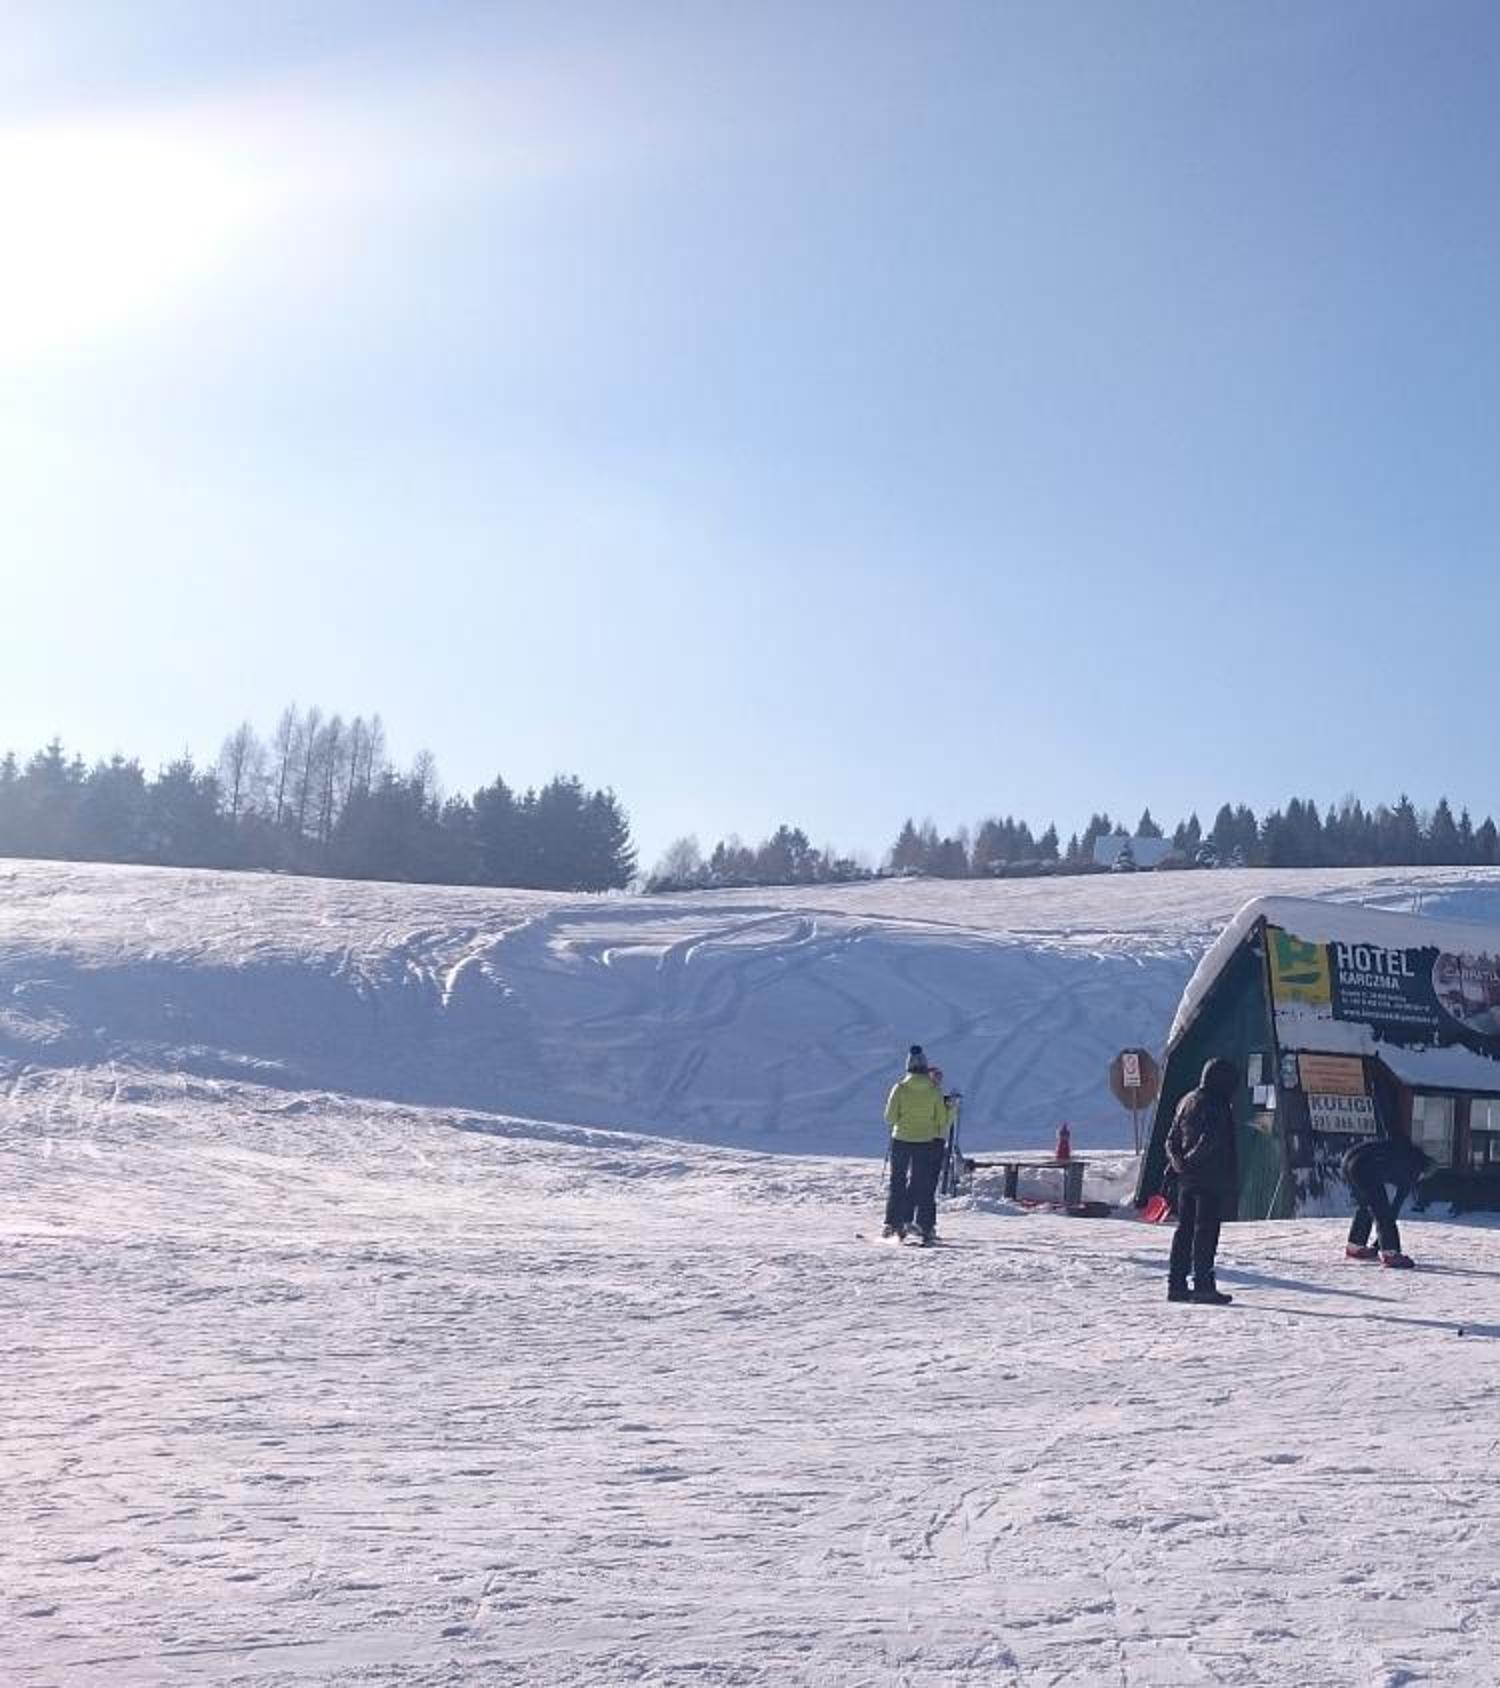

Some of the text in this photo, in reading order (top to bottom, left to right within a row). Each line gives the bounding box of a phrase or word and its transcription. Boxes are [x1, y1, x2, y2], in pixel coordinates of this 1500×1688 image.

[1337, 944, 1415, 976] HOTEL
[1340, 971, 1400, 990] KARCZMA
[1312, 1095, 1373, 1113] KULIGI
